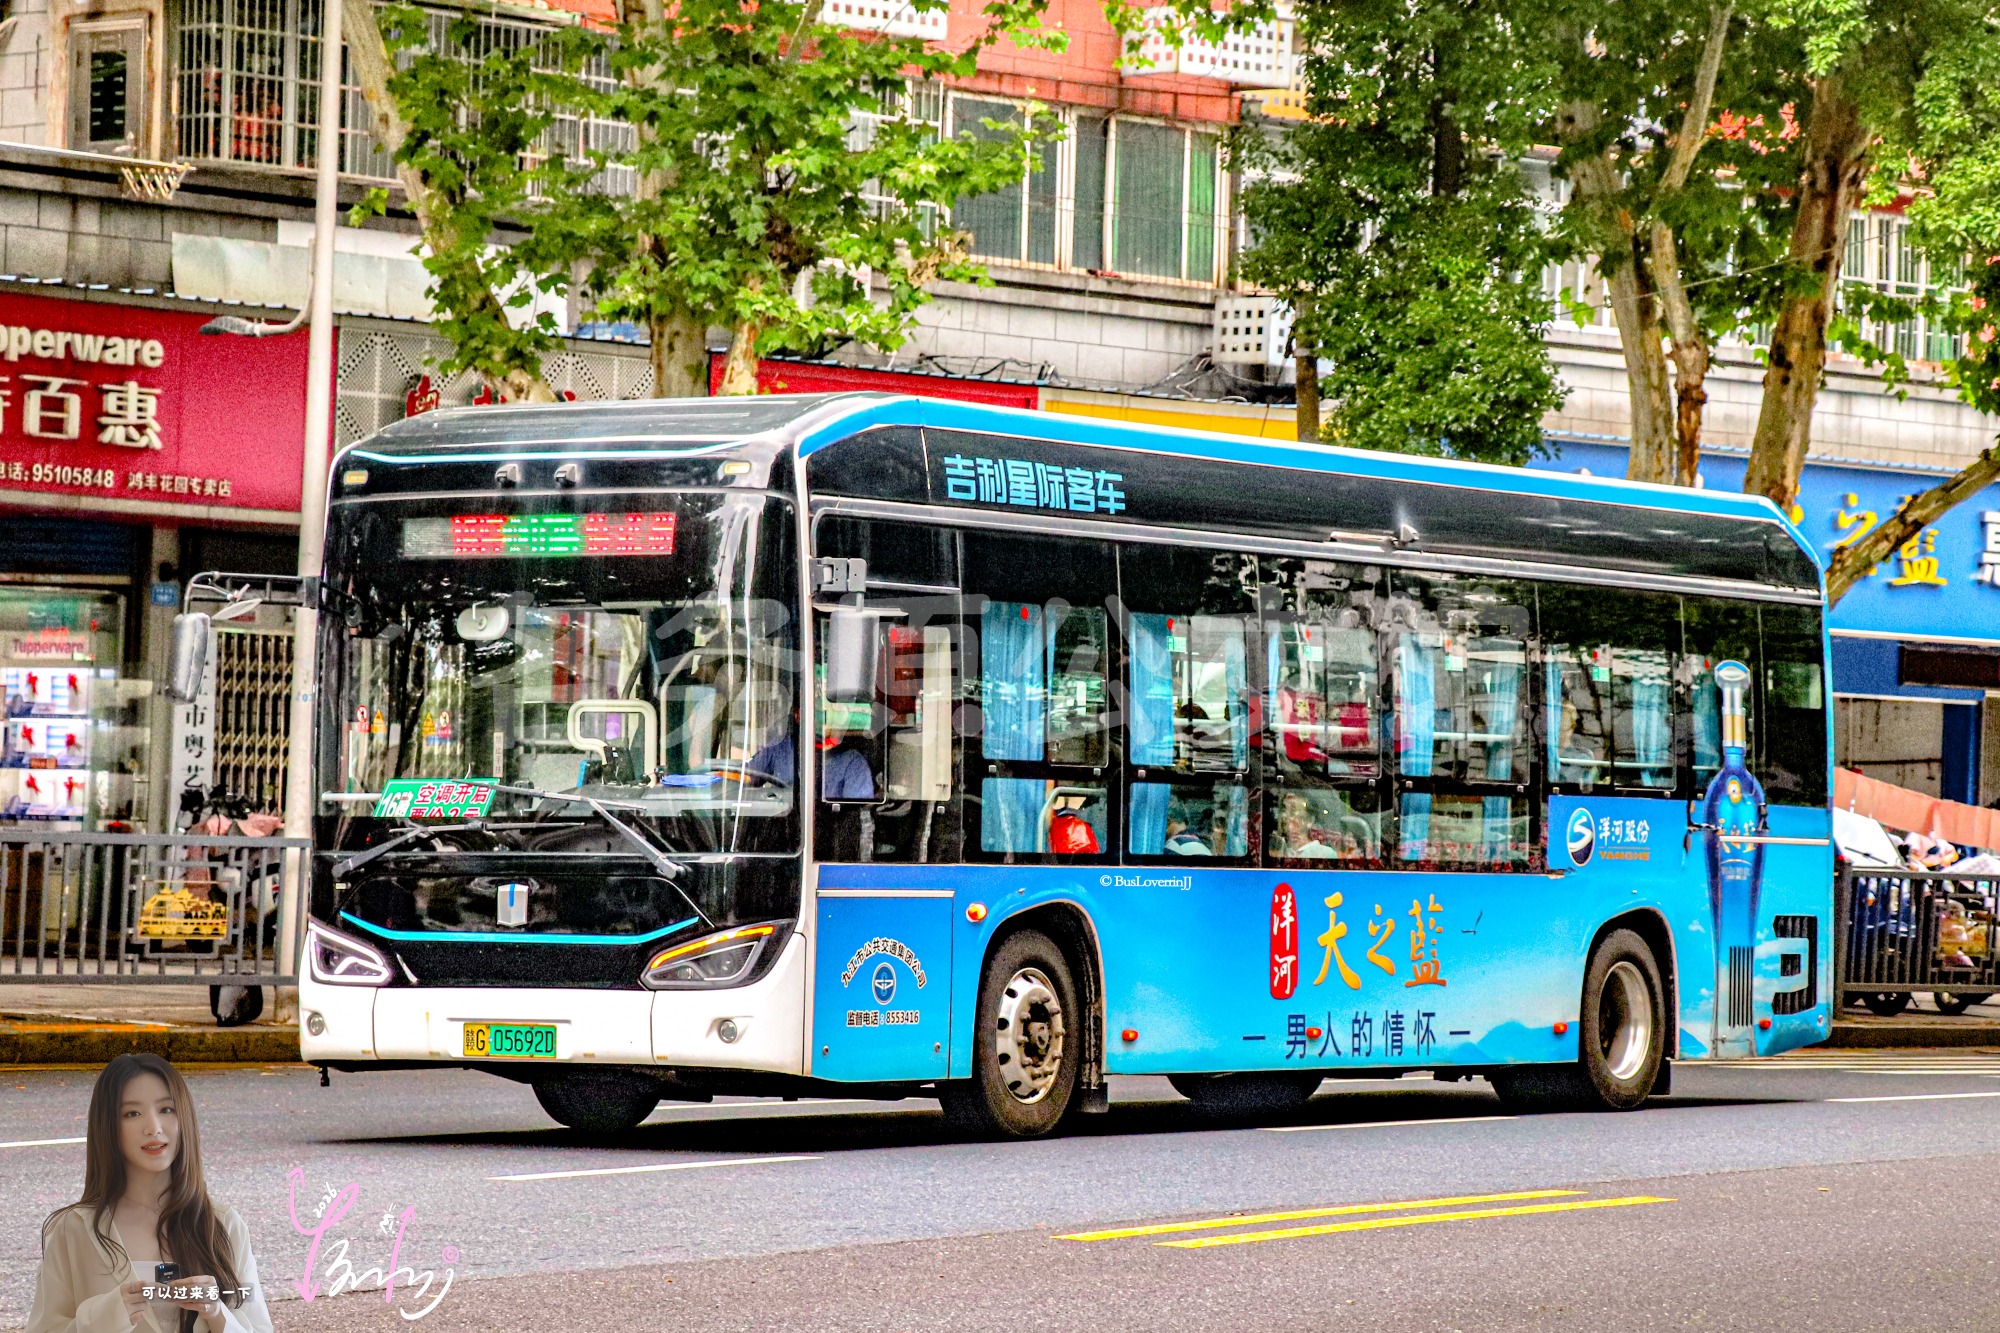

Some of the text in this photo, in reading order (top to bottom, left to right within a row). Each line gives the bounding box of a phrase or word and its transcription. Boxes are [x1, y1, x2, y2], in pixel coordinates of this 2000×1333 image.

[0, 374, 162, 450] 百惠
[944, 453, 1126, 514] 吉利星际客车
[416, 784, 490, 804] 空调开启
[1599, 817, 1650, 846] 洋河股份
[841, 937, 927, 989] 九江市公共交通集团公司
[1273, 892, 1297, 995] 洋河
